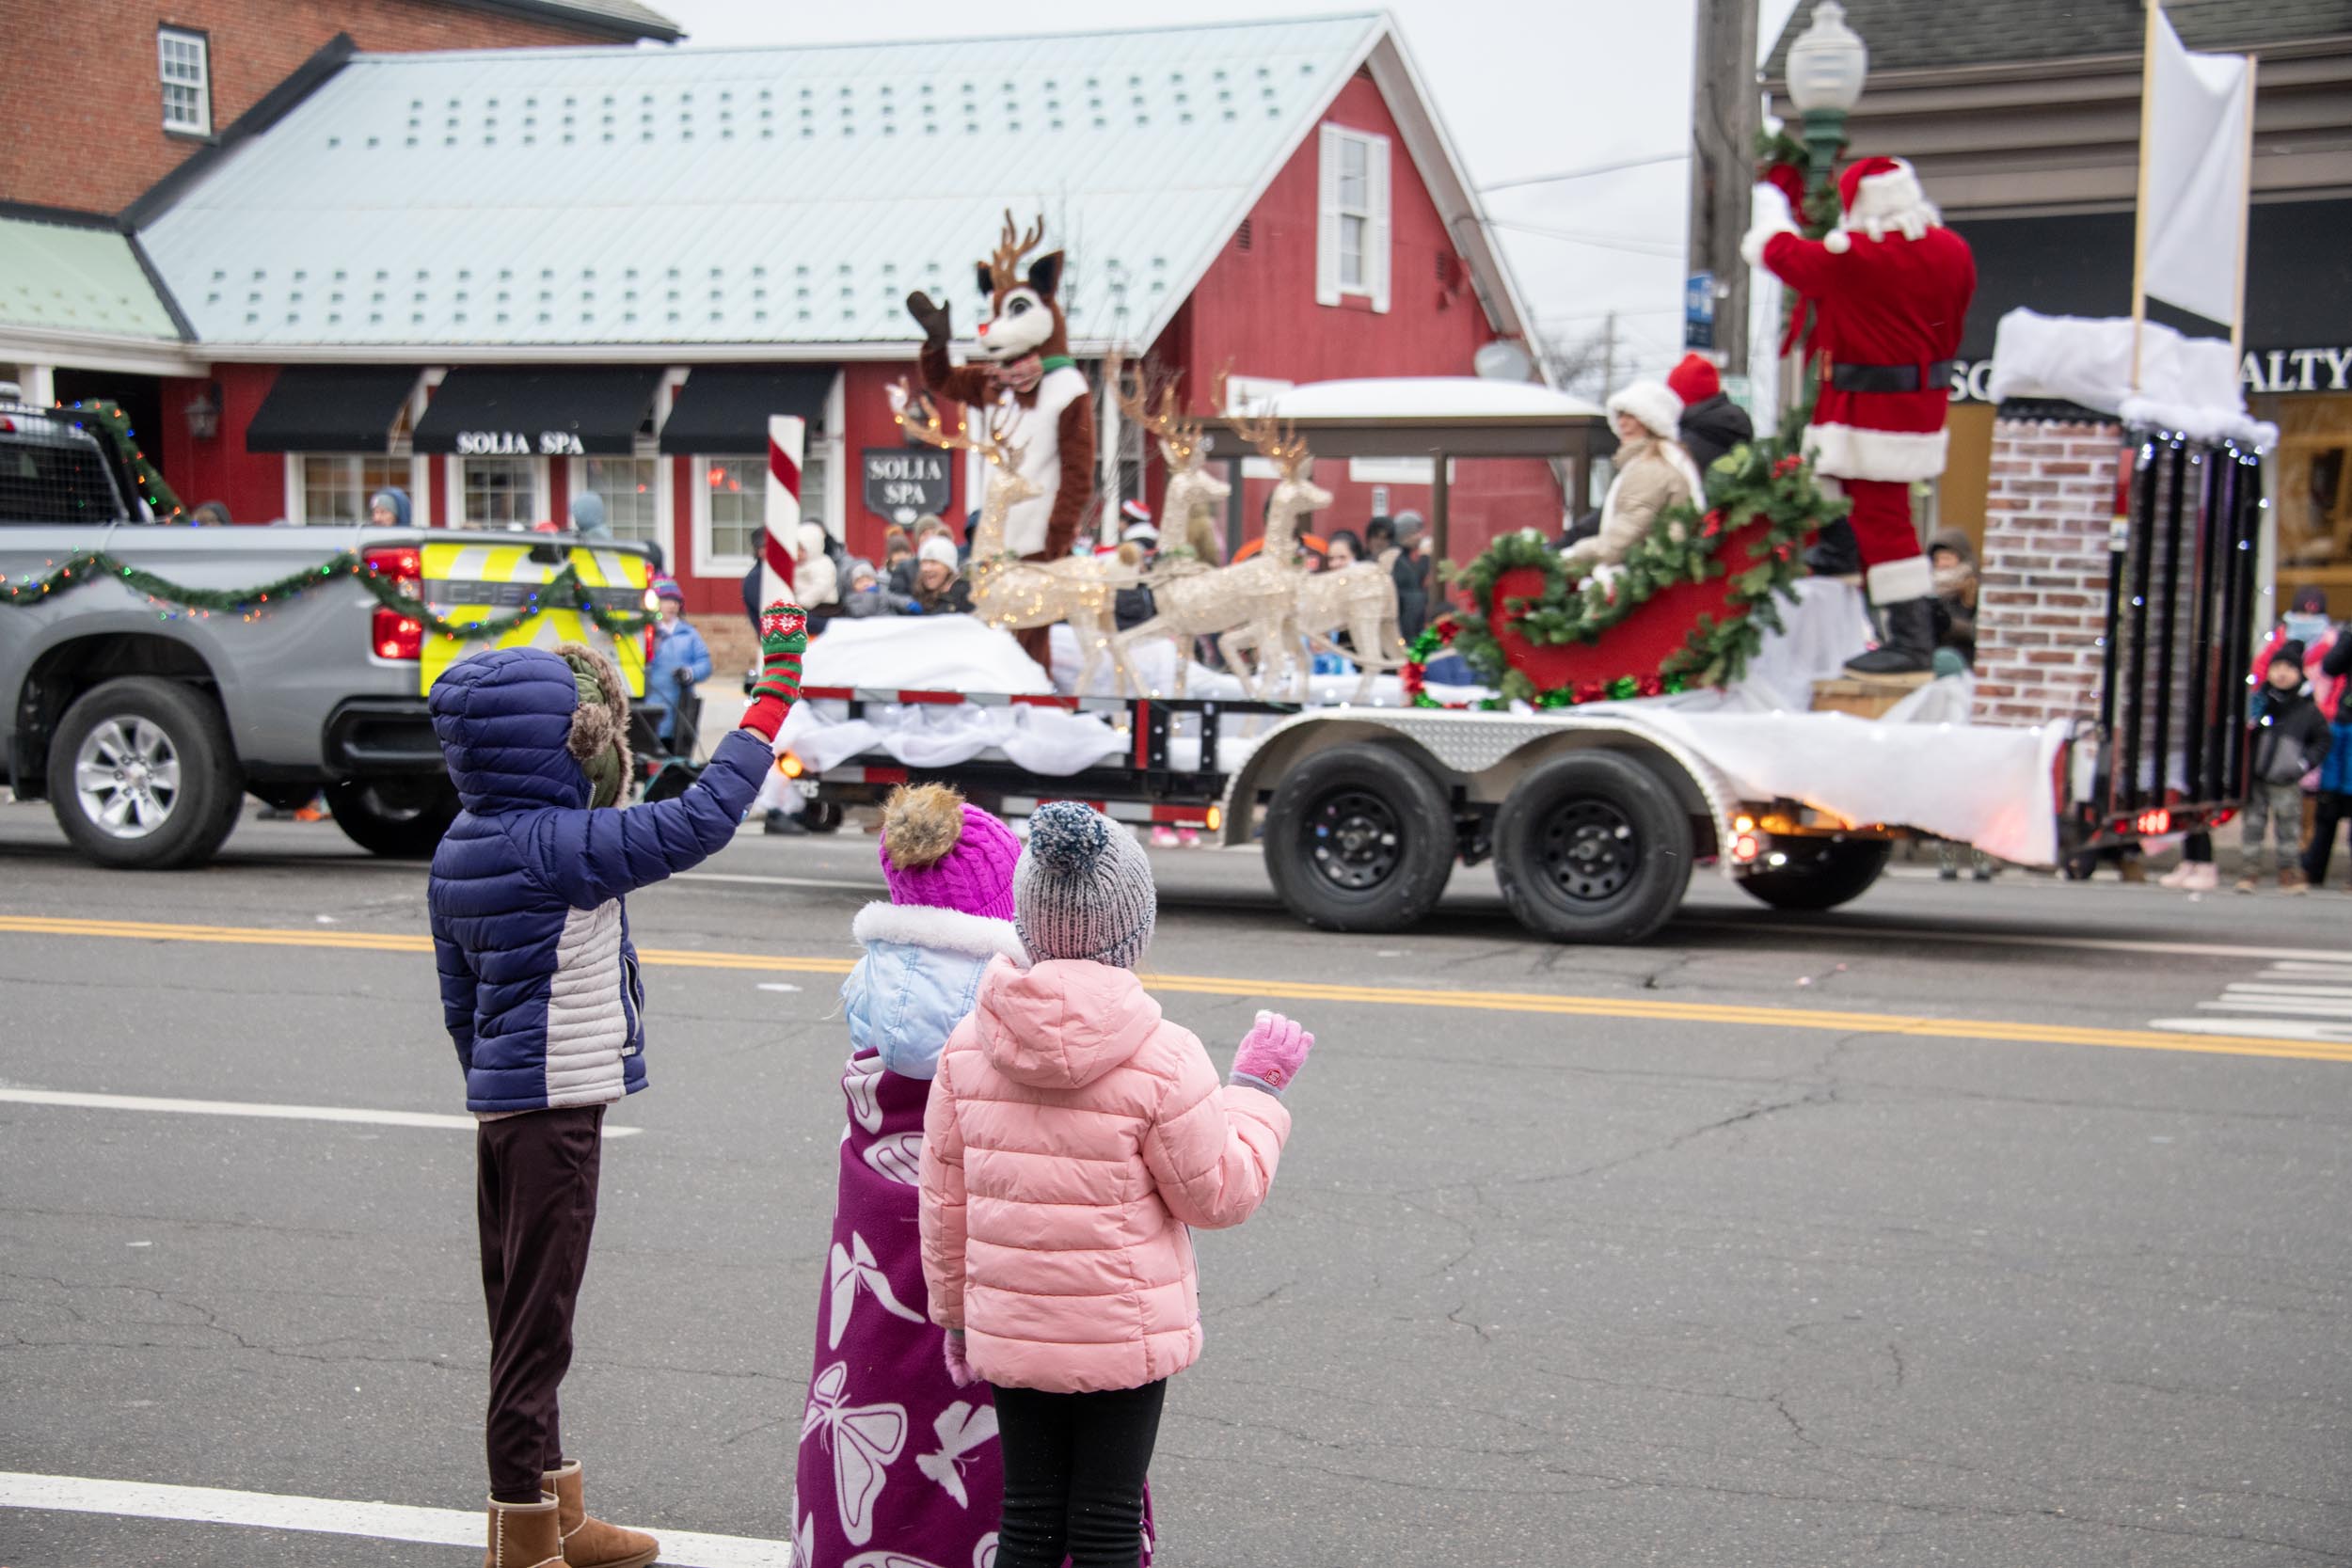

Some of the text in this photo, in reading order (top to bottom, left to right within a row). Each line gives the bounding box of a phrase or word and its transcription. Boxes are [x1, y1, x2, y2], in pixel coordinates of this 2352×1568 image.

[456, 431, 585, 454] SOLIA SPA
[869, 456, 942, 480] SOLIA
[884, 482, 926, 504] SPA
